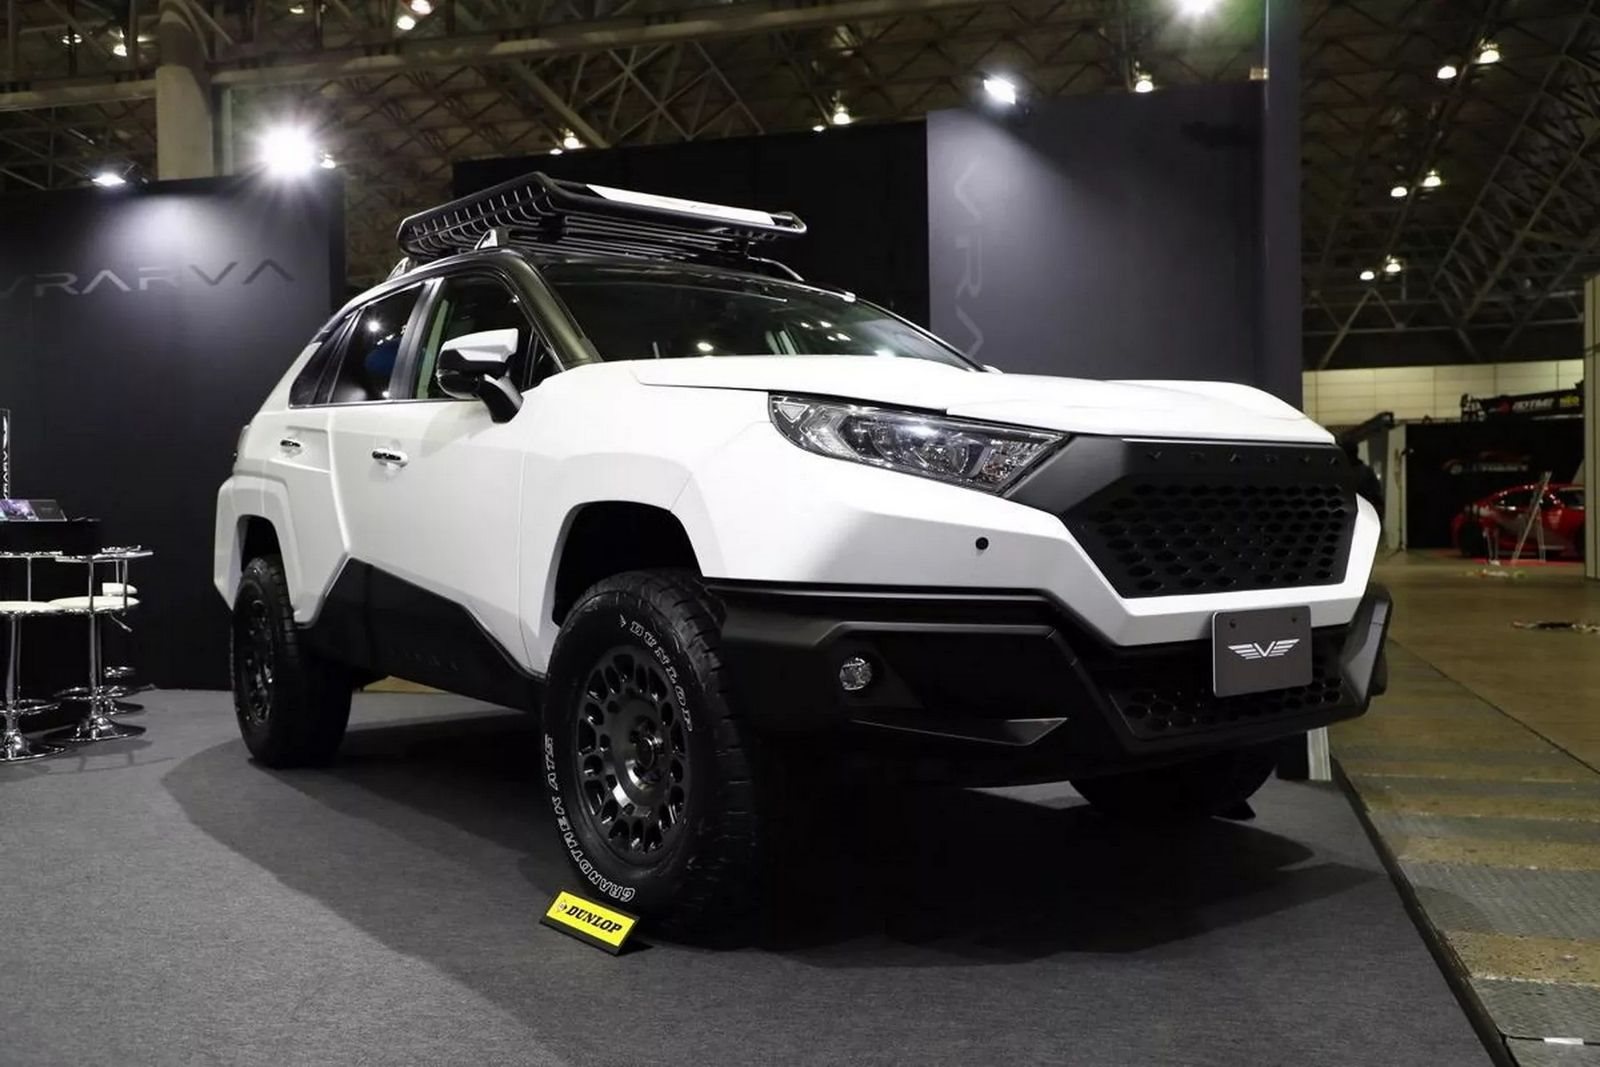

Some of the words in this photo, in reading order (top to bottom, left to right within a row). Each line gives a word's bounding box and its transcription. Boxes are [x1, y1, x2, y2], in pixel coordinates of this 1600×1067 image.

[629, 619, 693, 733] DUNLOP
[551, 795, 636, 903] GRANDTREK
[566, 905, 622, 933] DUNLOP
